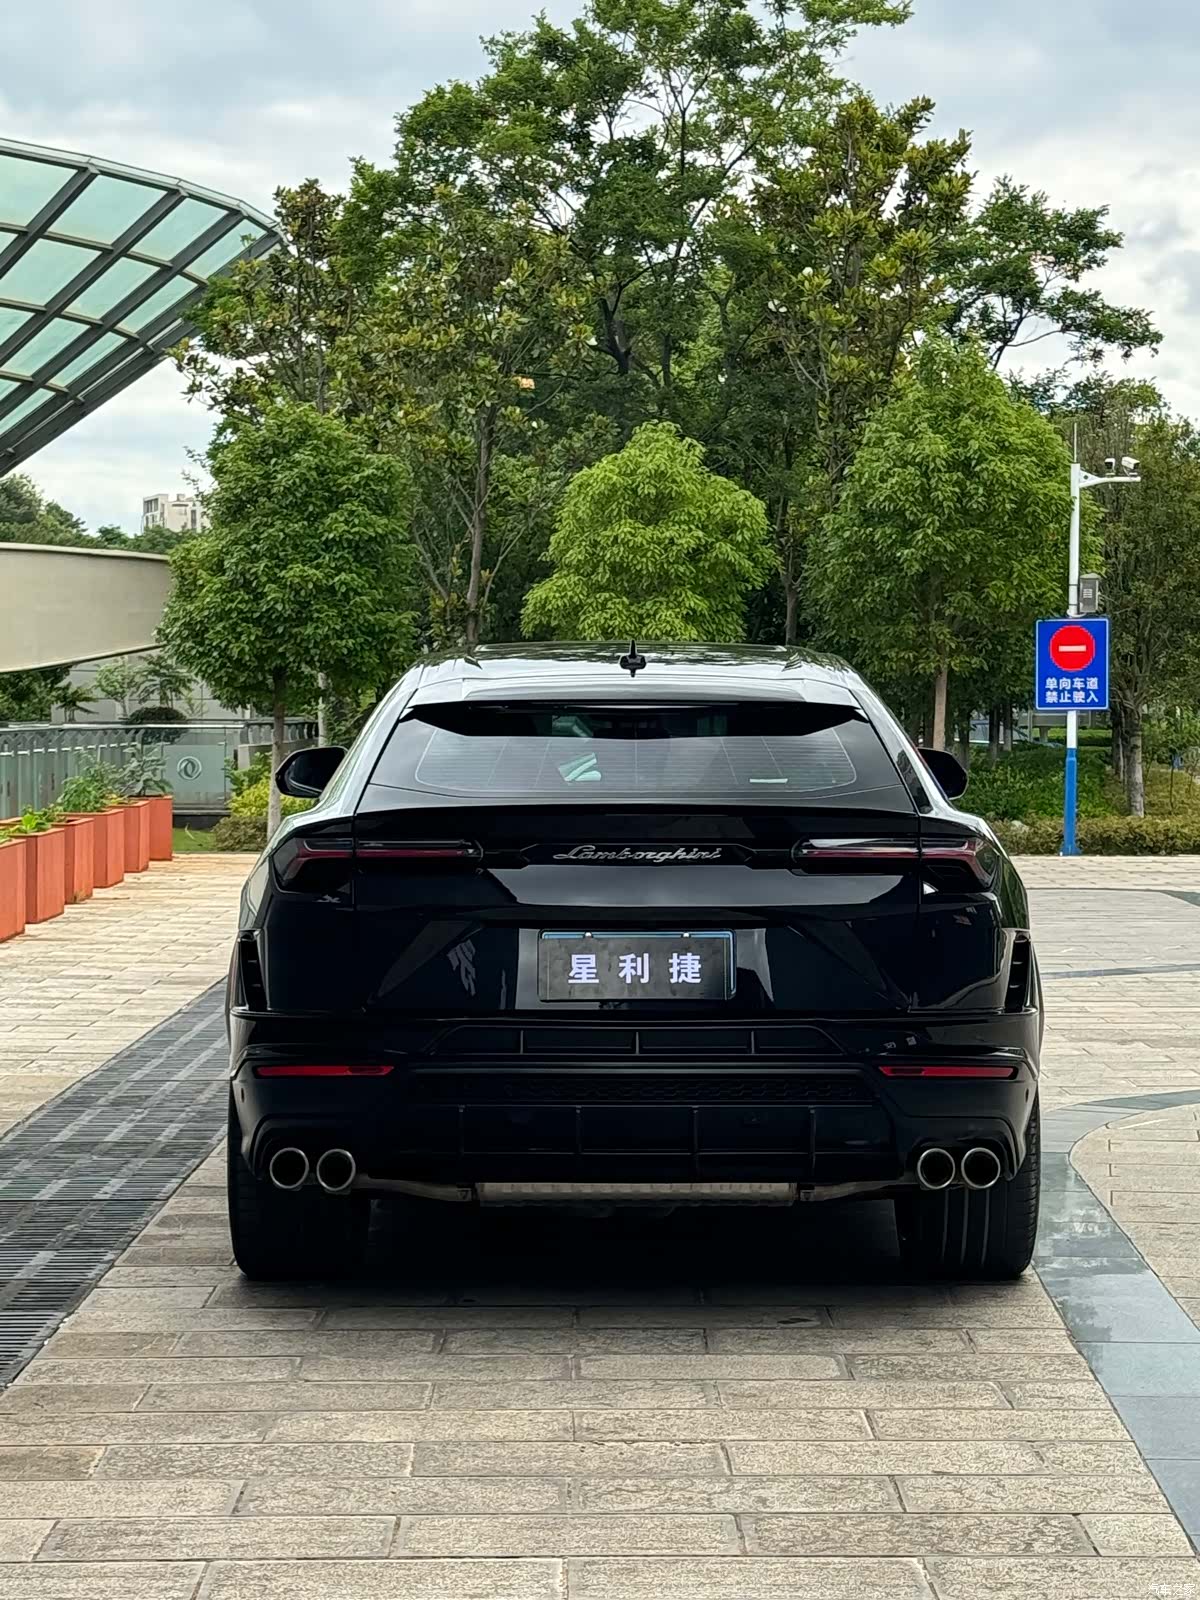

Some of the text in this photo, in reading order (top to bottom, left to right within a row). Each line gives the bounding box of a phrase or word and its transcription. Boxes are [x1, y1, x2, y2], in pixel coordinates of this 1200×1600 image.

[1045, 677, 1098, 690] 单向车道
[1045, 691, 1098, 703] 禁止驶入
[553, 845, 722, 863] Lamborghini
[567, 952, 702, 984] 星利捷
